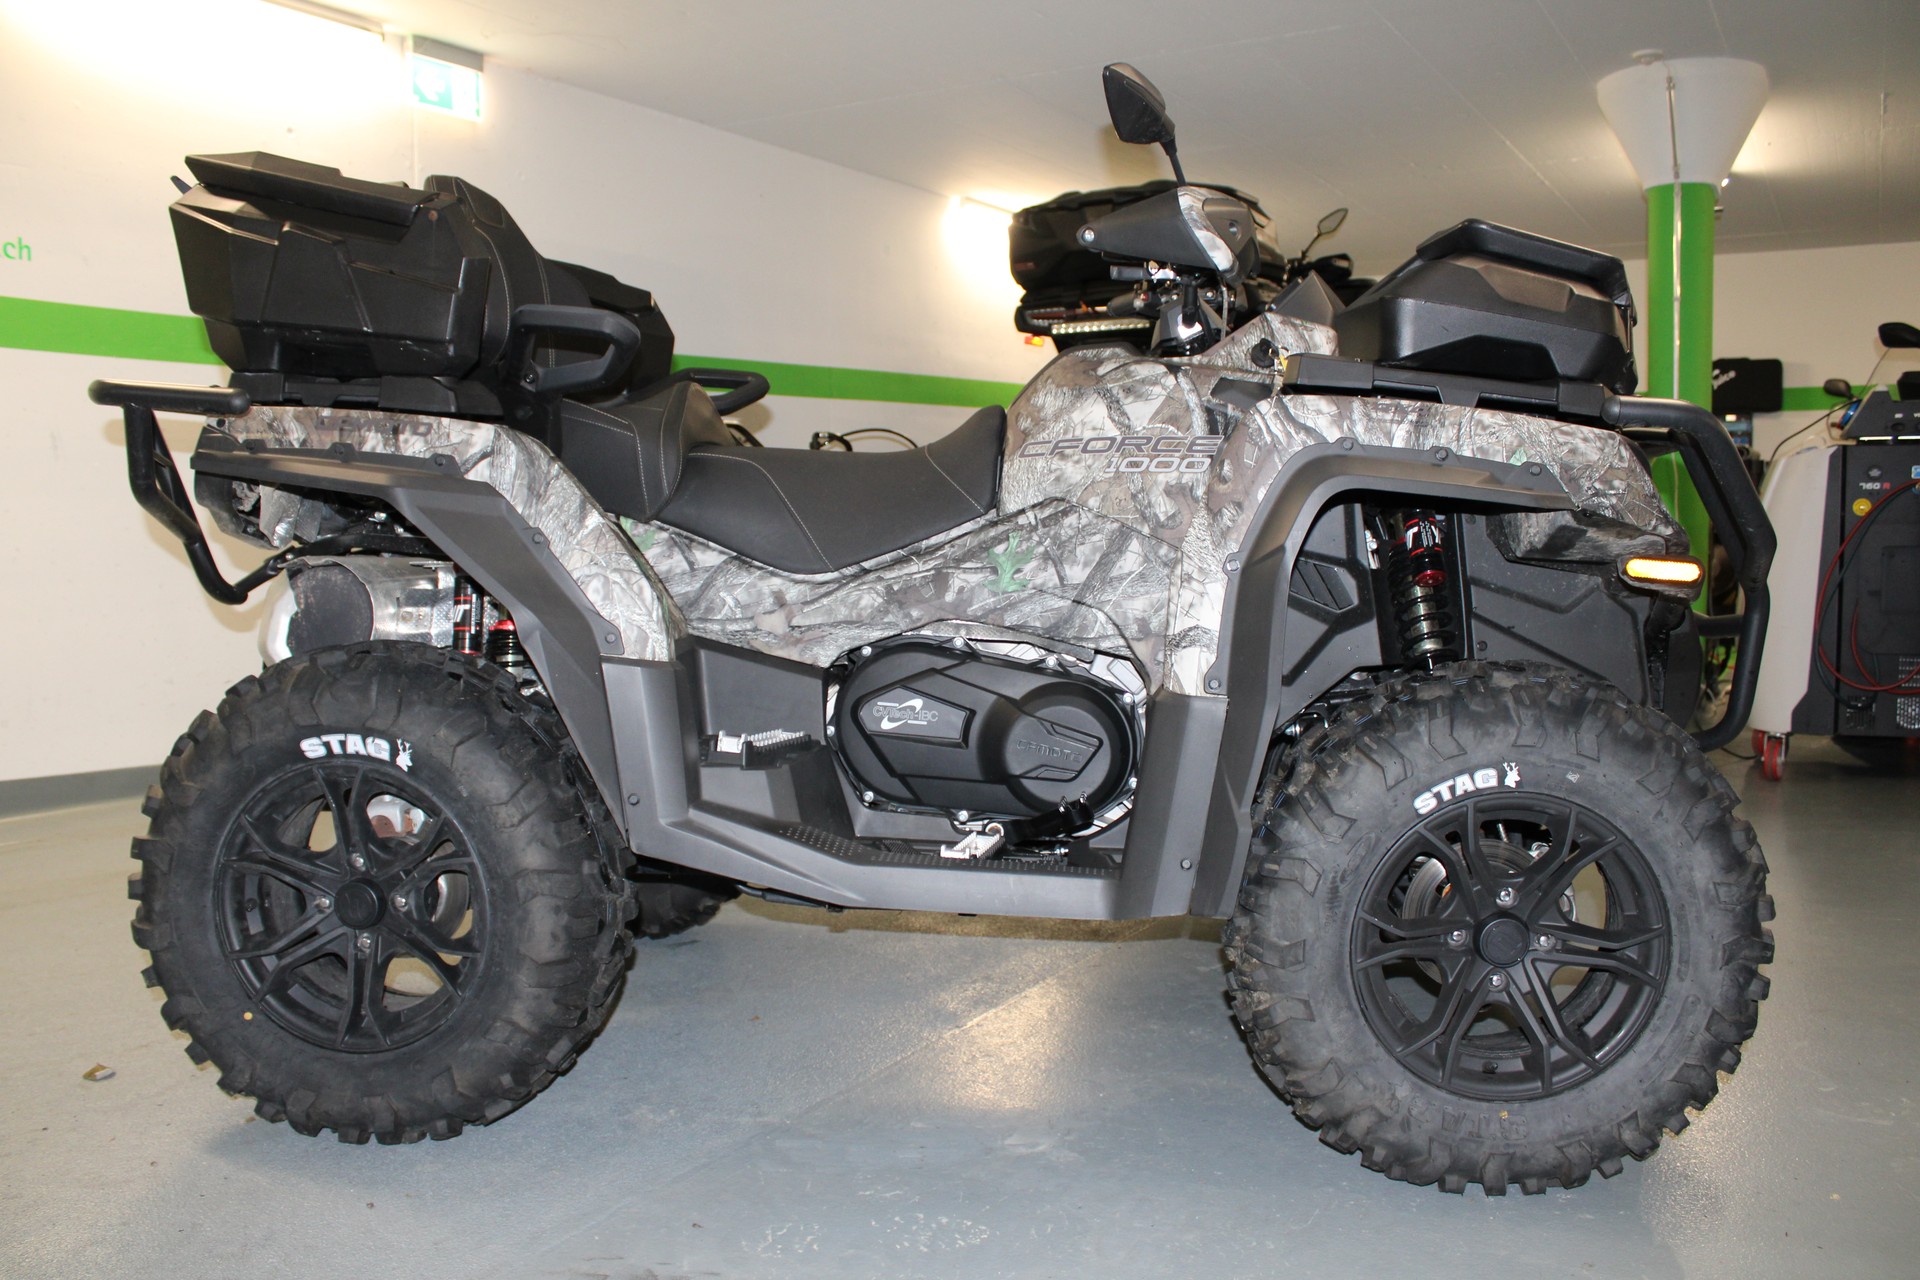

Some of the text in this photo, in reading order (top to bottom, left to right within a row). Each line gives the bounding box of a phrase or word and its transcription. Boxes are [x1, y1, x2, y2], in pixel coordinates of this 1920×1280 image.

[1018, 434, 1224, 459] CFORCE
[1104, 456, 1211, 474] 1000
[872, 704, 939, 723] CVTech-IBC
[300, 733, 391, 762] STAG
[1016, 739, 1083, 764] CFMOTO
[1413, 767, 1498, 815] STAG
